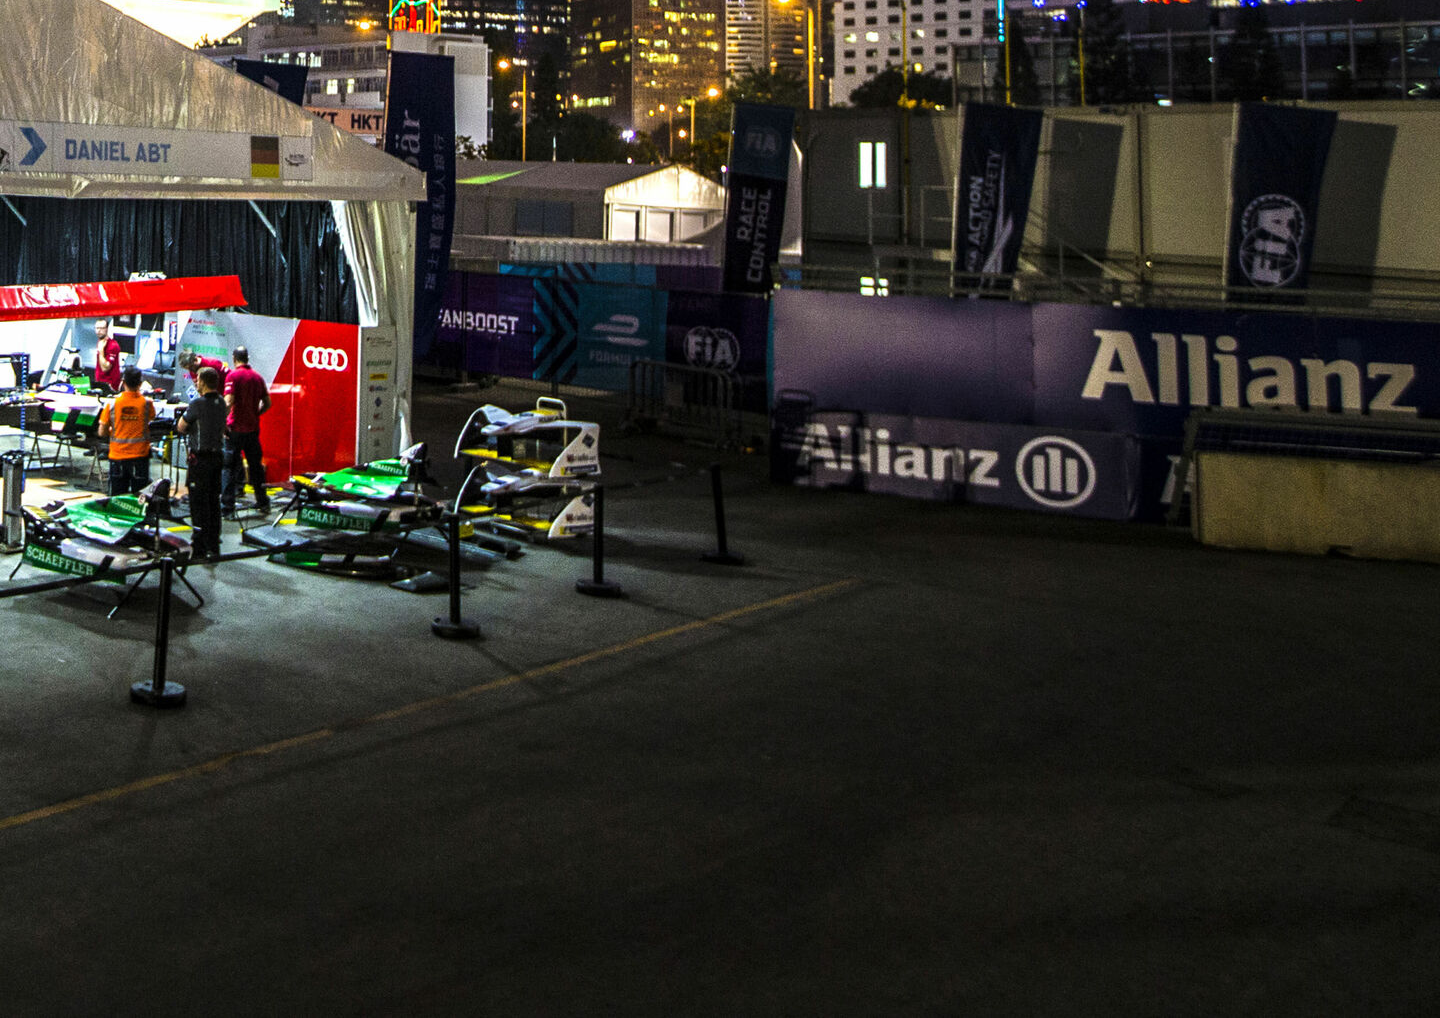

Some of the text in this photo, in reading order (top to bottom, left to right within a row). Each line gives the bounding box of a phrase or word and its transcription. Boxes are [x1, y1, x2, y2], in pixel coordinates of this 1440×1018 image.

[350, 113, 383, 131] HKT
[65, 138, 172, 164] DANIEL ABT
[735, 186, 758, 242] RACE
[966, 175, 985, 247] ACTION
[746, 187, 772, 283] CONTROL
[1081, 329, 1418, 413] Allianz
[301, 508, 371, 532] SCHAEFFLER
[26, 544, 94, 577] SCHAEFFLER
